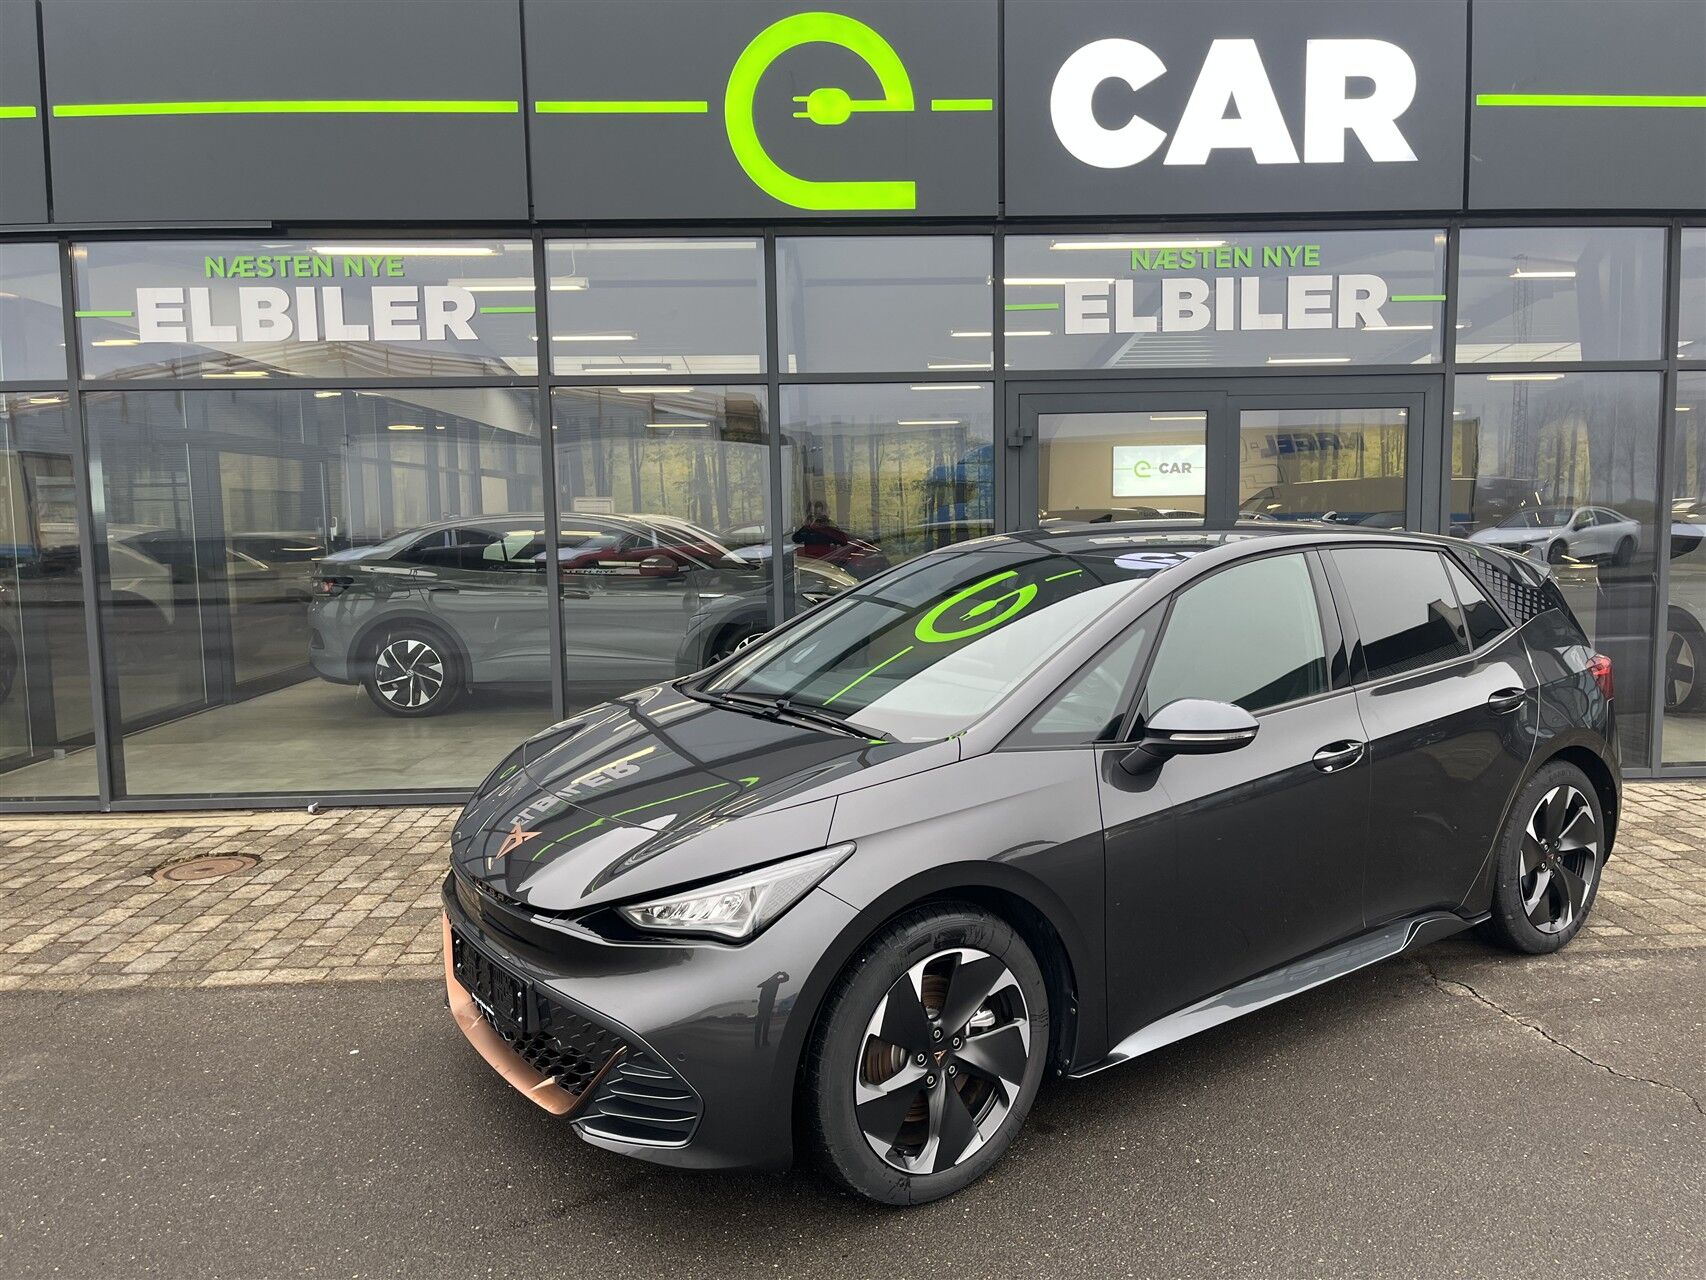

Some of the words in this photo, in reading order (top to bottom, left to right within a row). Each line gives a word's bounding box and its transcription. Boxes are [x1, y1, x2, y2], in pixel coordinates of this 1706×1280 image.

[1050, 38, 1419, 168] CAR
[204, 255, 333, 278] NÆSTEN
[343, 255, 405, 278] NYE
[1130, 246, 1253, 270] NÆSTEN
[1262, 244, 1321, 268] NYE
[136, 284, 480, 343] ELBILER
[1064, 274, 1390, 334] ELBILER
[1158, 462, 1192, 474] CAR
